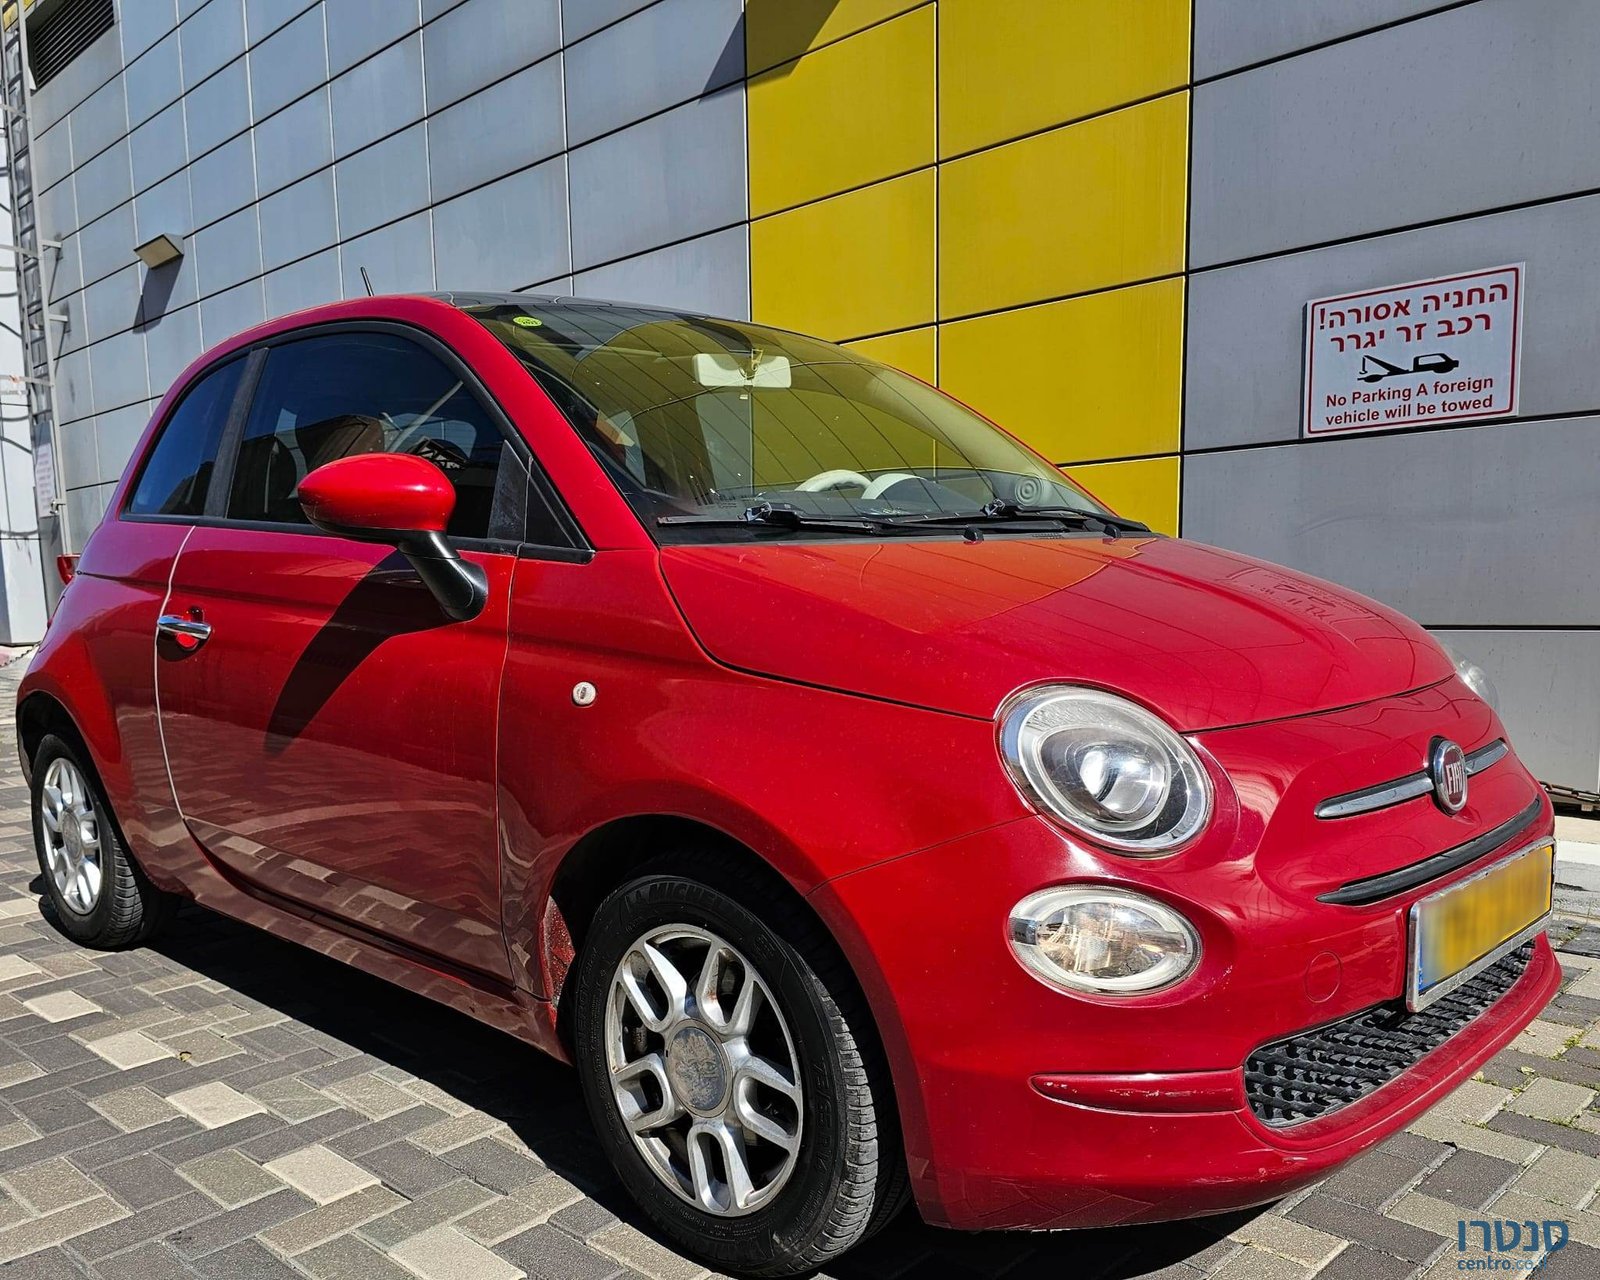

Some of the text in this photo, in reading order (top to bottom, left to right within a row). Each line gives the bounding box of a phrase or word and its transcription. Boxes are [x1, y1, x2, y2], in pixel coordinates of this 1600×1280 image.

[1319, 283, 1508, 330] החניה אסורה!
[1330, 313, 1491, 352] רכב זר יגרר
[1325, 394, 1493, 425] vehicle will be towed
[1326, 377, 1494, 408] No Parking A foreign
[1445, 761, 1465, 795] FIAT
